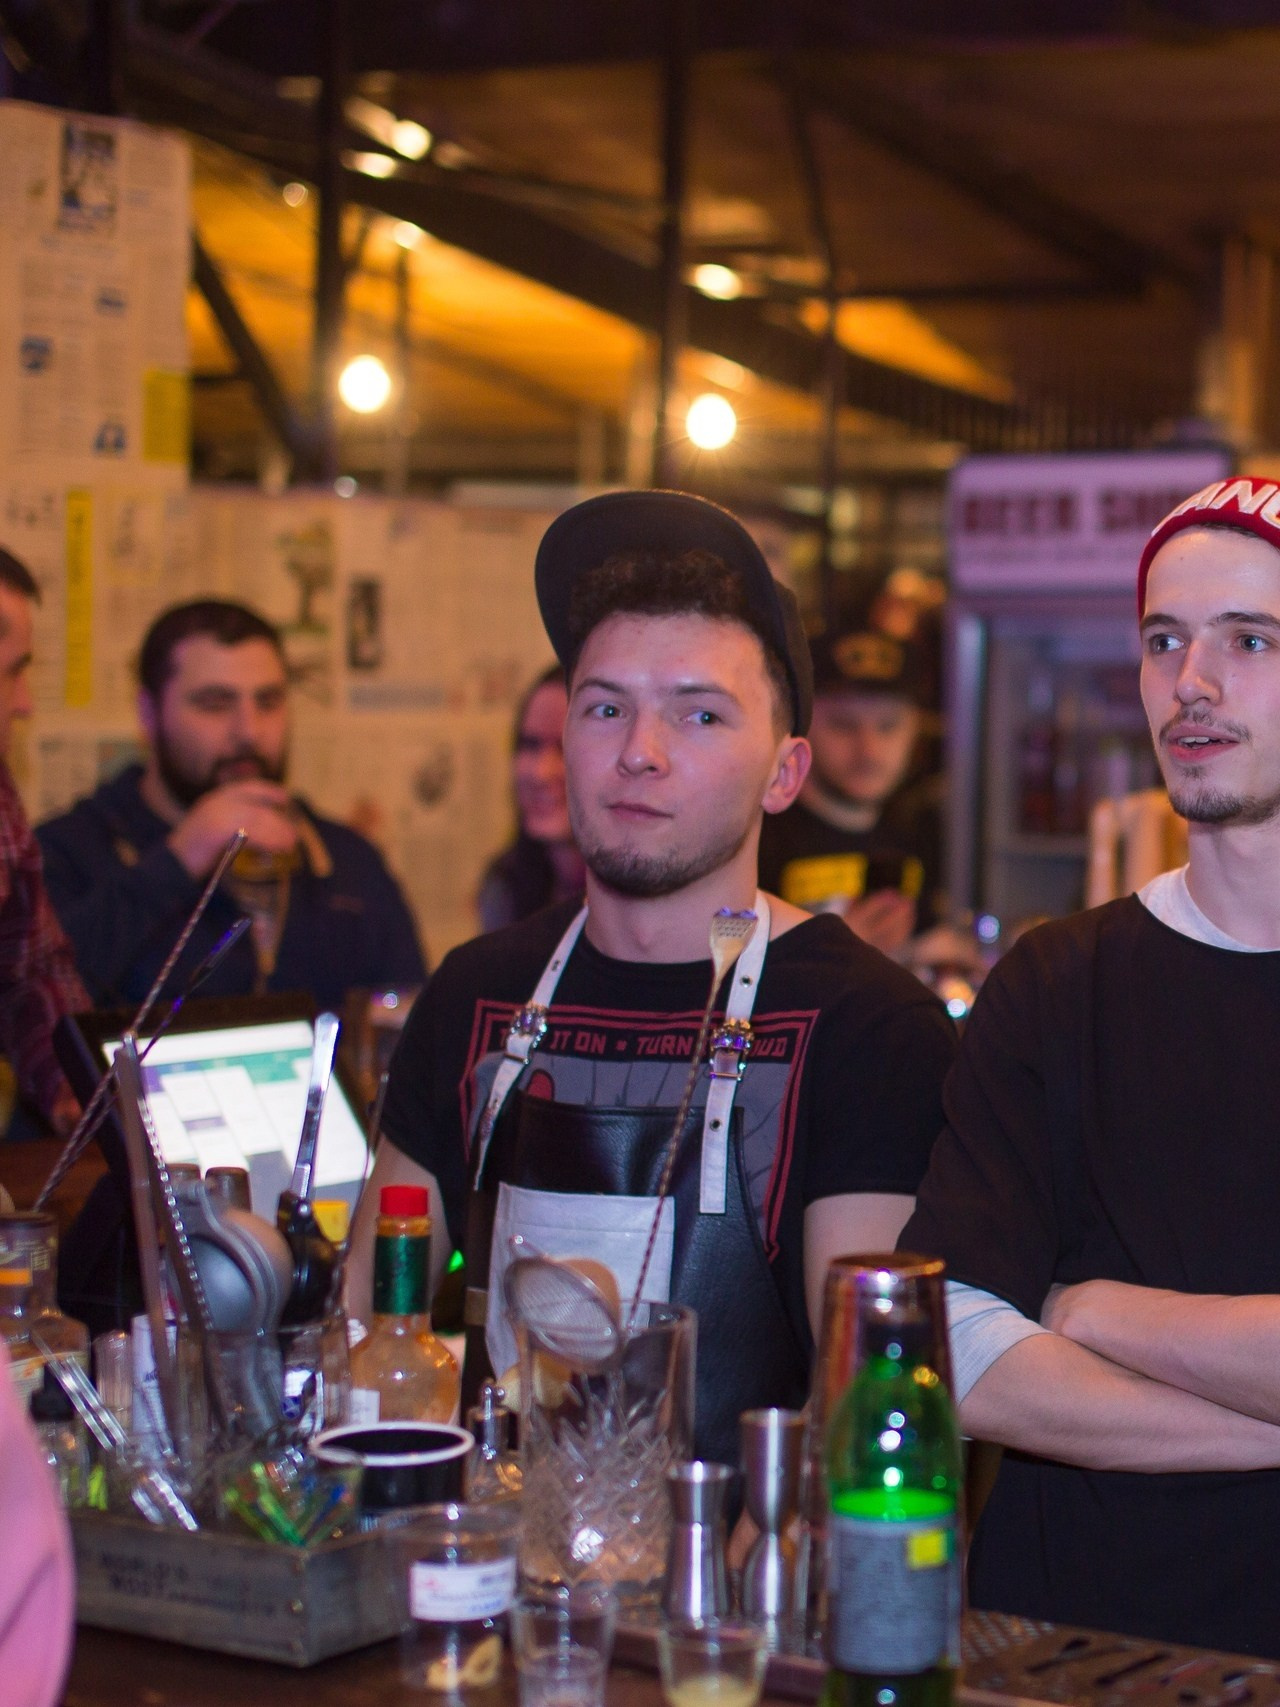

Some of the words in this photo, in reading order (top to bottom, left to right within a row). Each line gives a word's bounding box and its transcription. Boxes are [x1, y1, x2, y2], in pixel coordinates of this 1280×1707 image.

[550, 1030, 572, 1050] IT
[574, 1031, 606, 1054] ON
[636, 1034, 694, 1056] TURN
